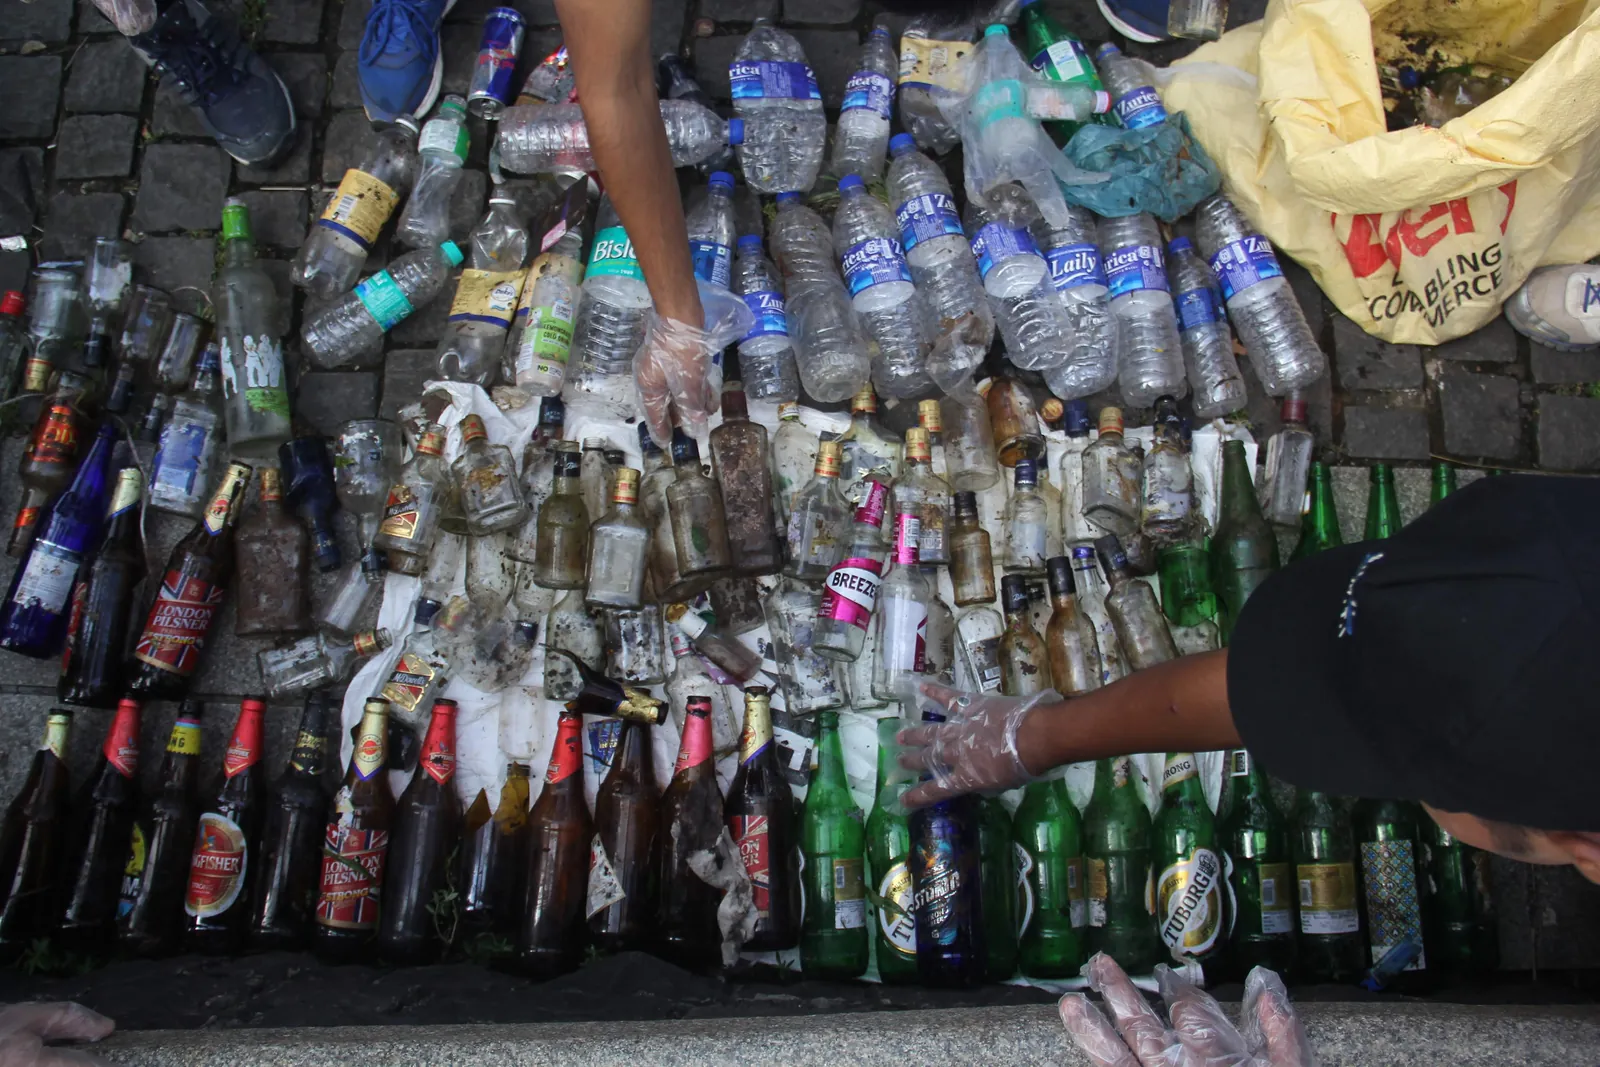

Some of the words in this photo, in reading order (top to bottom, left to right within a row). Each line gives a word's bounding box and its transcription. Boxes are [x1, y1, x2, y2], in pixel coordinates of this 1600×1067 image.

[1052, 252, 1097, 279] Laily
[537, 364, 549, 372] NO
[152, 615, 209, 630] PILSNER
[325, 855, 381, 874] LONON
[1163, 872, 1211, 943] TUBORG
